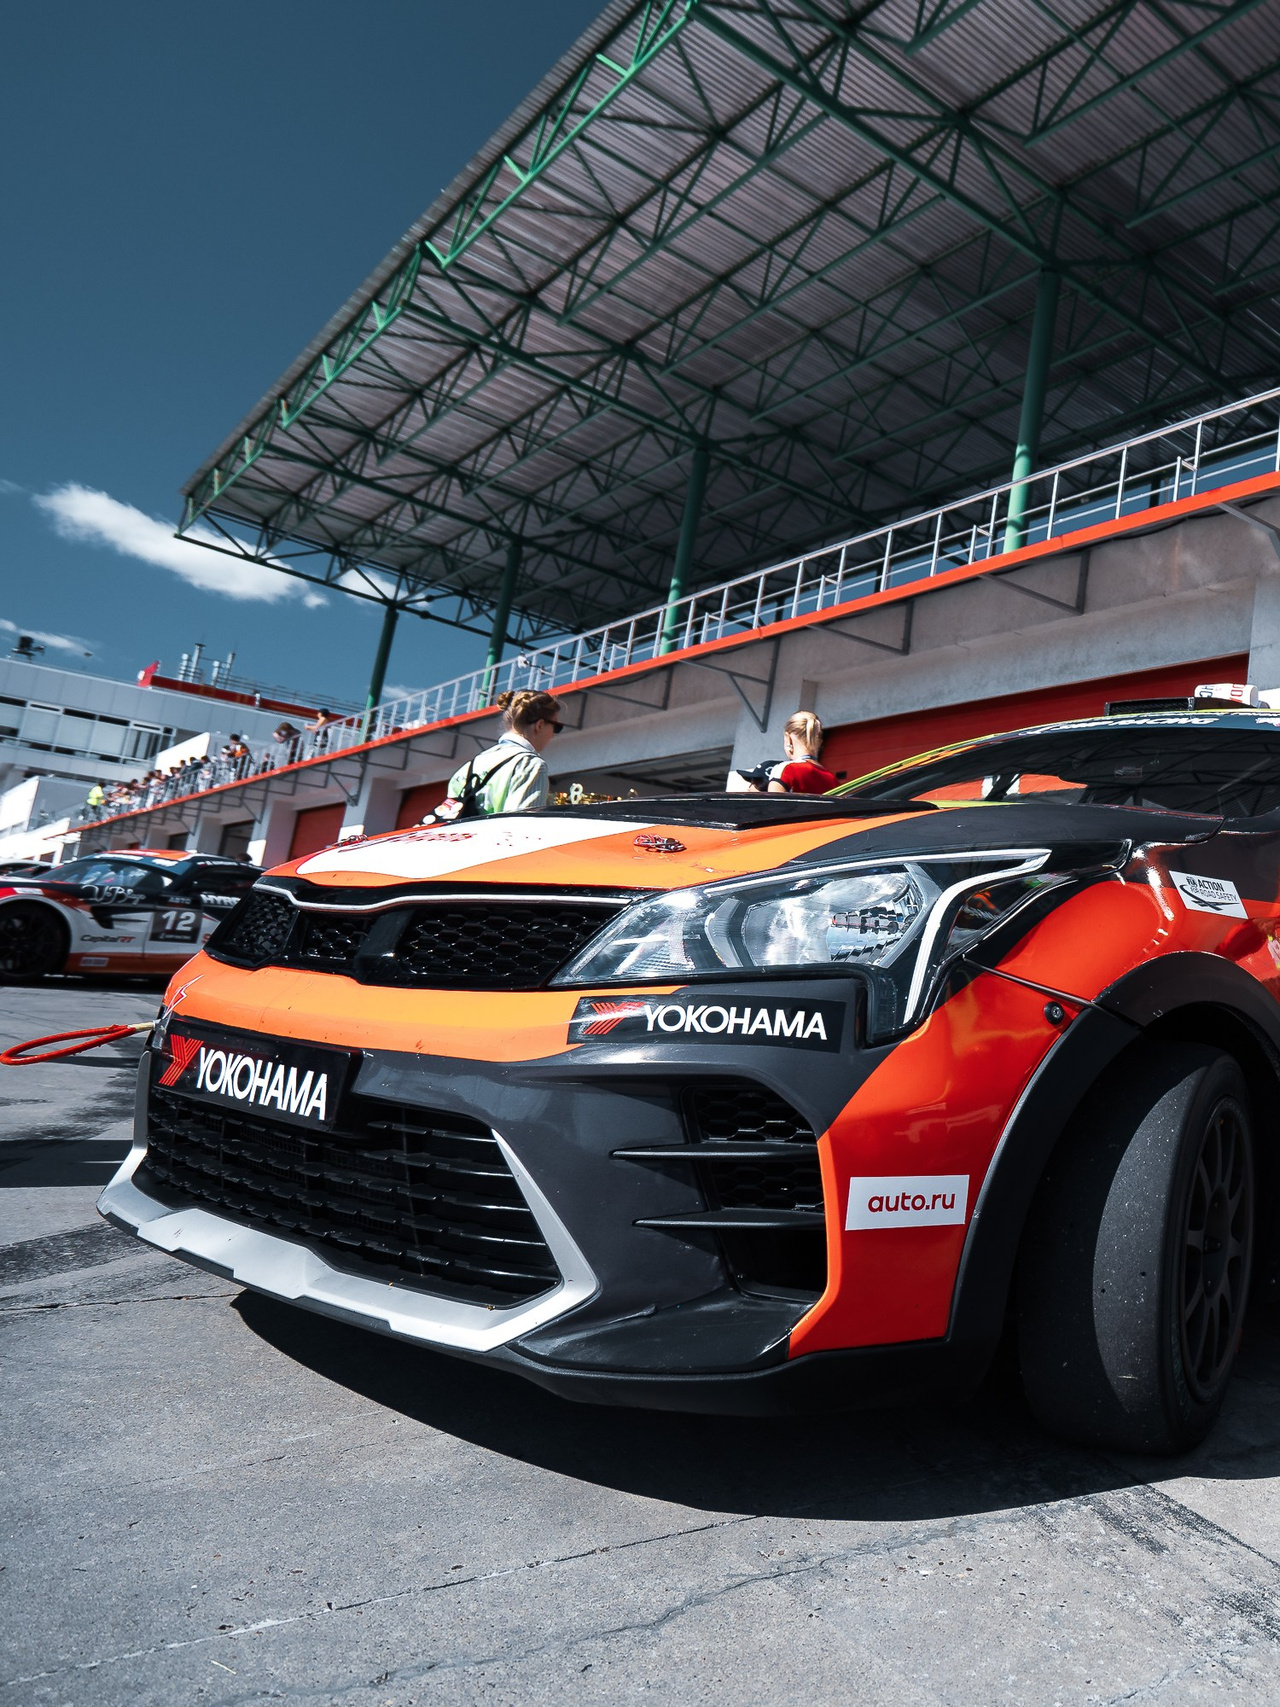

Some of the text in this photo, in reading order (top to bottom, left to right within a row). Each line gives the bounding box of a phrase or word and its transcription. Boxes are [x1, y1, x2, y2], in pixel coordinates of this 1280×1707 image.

[1197, 879, 1225, 892] ACTION
[162, 910, 195, 931] 12
[643, 1004, 828, 1041] YOKOHAMA
[196, 1046, 328, 1121] YOKOHAMA
[867, 1191, 956, 1213] auto.ru
